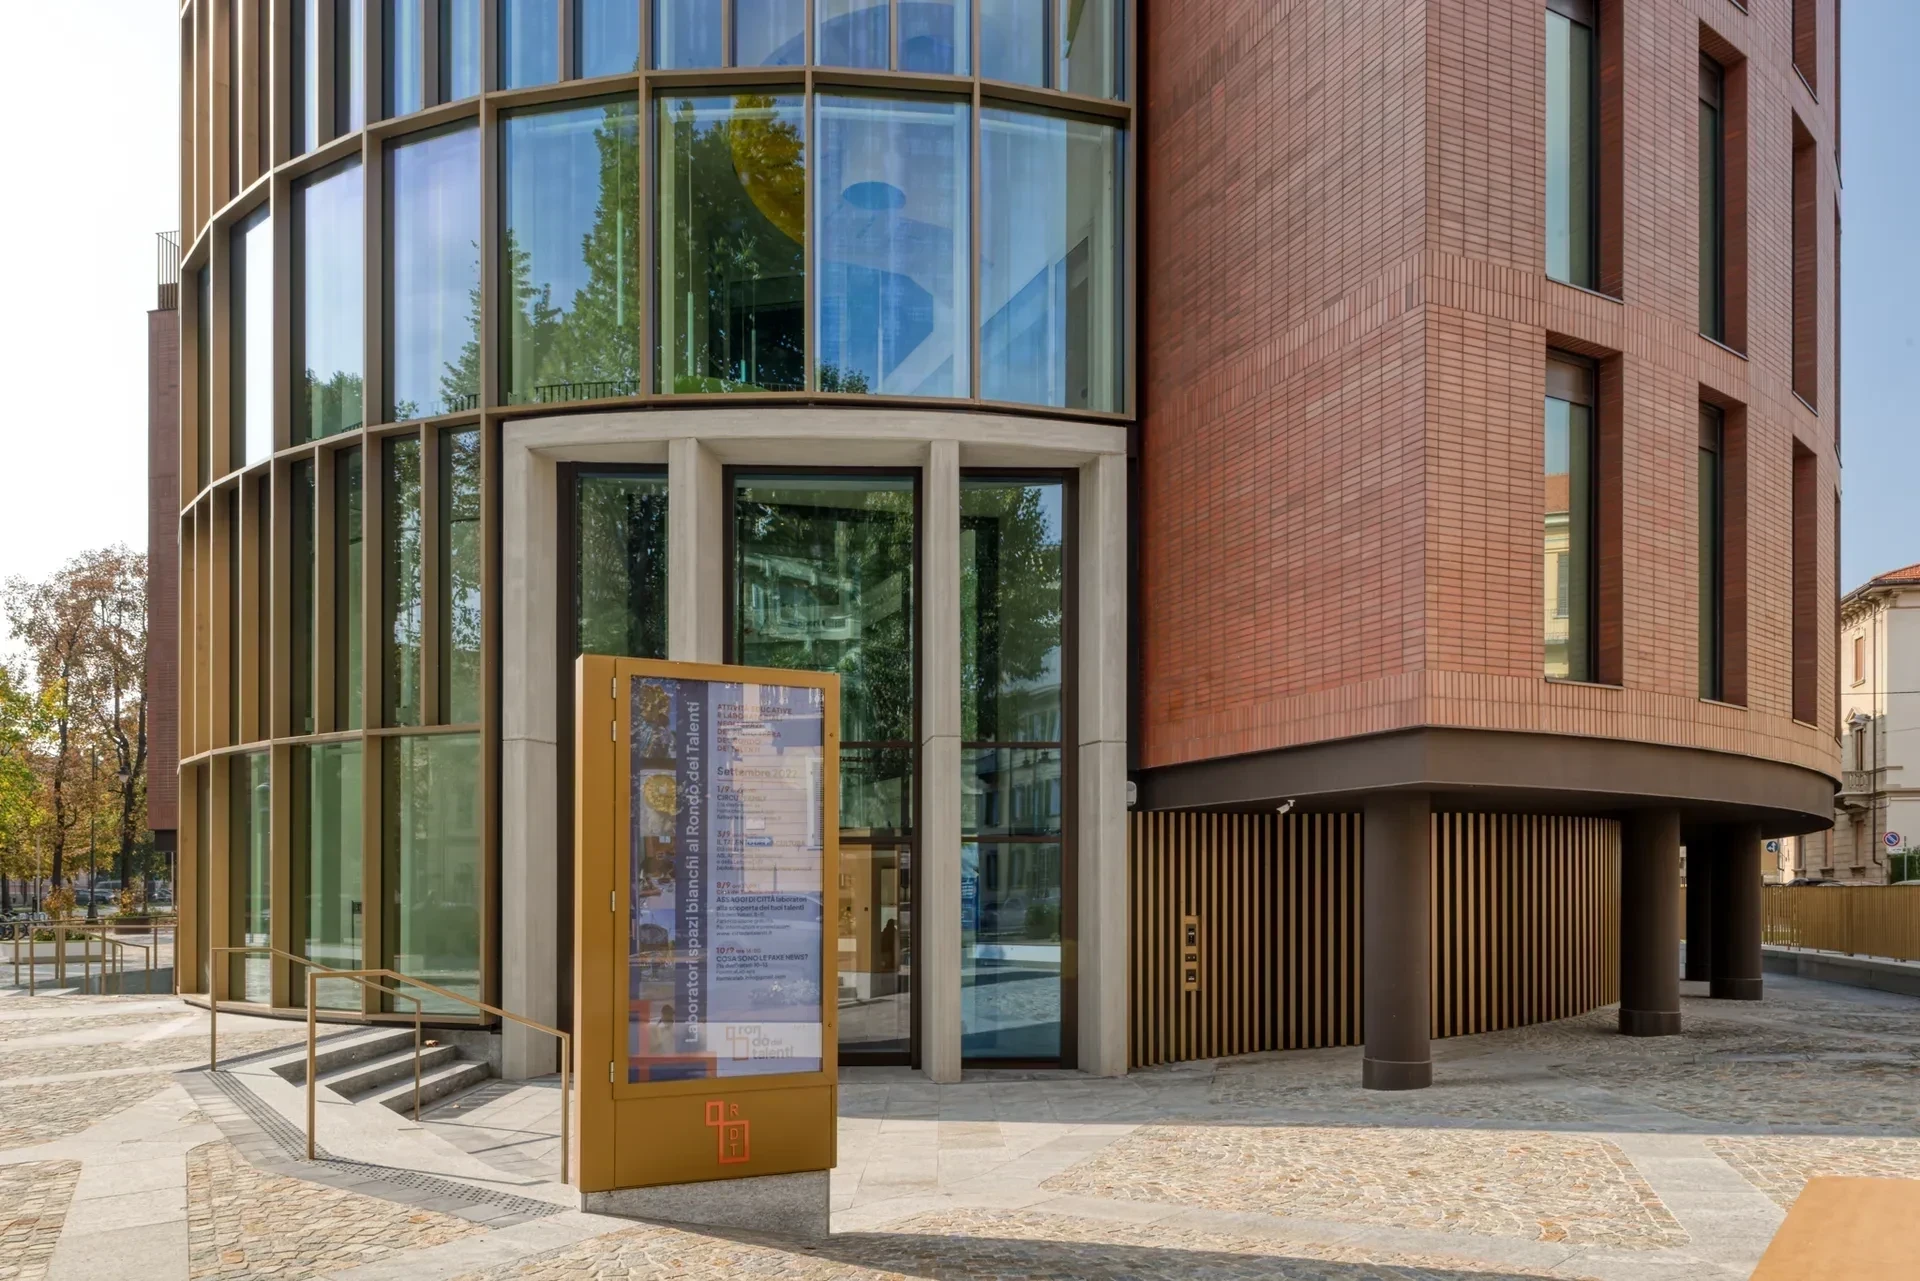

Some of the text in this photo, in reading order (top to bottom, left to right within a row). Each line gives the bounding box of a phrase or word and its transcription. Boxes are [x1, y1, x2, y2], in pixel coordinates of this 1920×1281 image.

[717, 766, 770, 777] Settembre
[685, 701, 701, 1043] Laboratori spazi bianchi al Rondò dei Talenti
[716, 881, 731, 889] 8/9
[756, 895, 775, 903] CITTÀ
[716, 946, 735, 955] 10/9
[716, 955, 738, 963] COSA
[768, 953, 786, 961] FAKE
[785, 953, 809, 961] NEWS?
[752, 1045, 795, 1060] talenti
